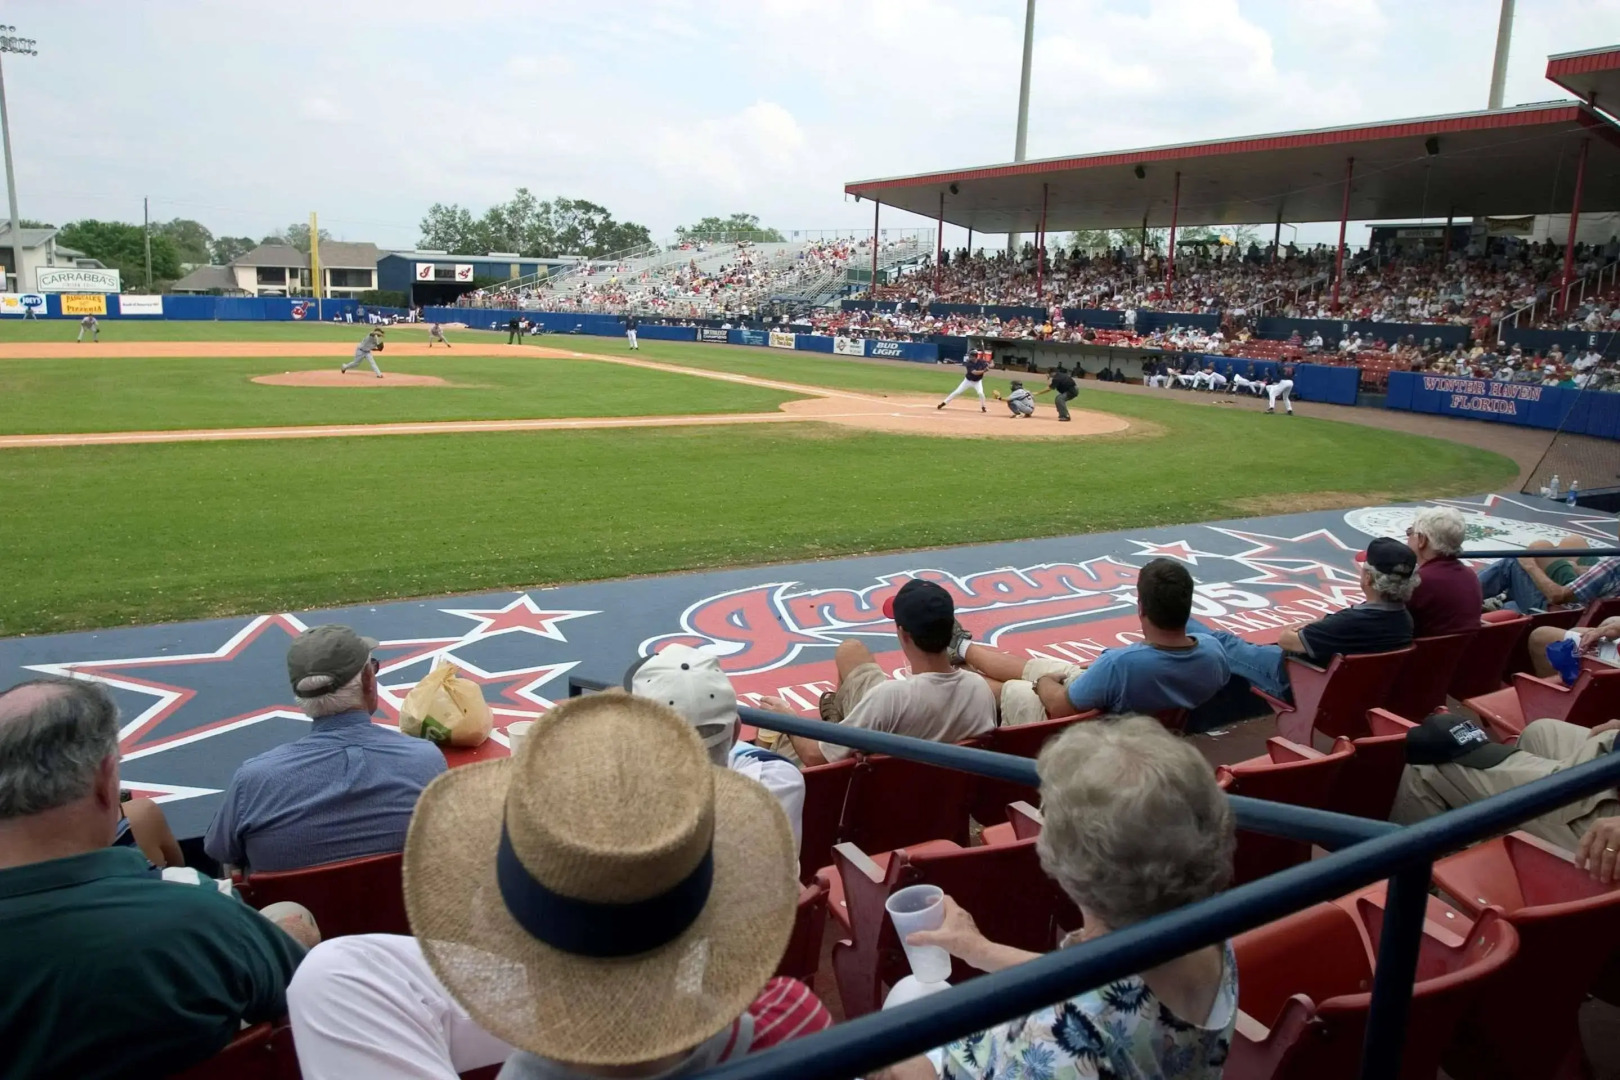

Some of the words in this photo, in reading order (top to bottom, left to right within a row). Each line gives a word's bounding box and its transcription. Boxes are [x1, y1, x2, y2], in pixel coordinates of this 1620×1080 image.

[42, 272, 115, 287] CARRABBA'S
[876, 341, 899, 350] BUD
[1588, 334, 1596, 346] E
[871, 348, 903, 357] LIGHT
[1423, 376, 1485, 395] WINTER
[1490, 382, 1542, 401] HAVEN
[1450, 394, 1517, 415] FLORIDA
